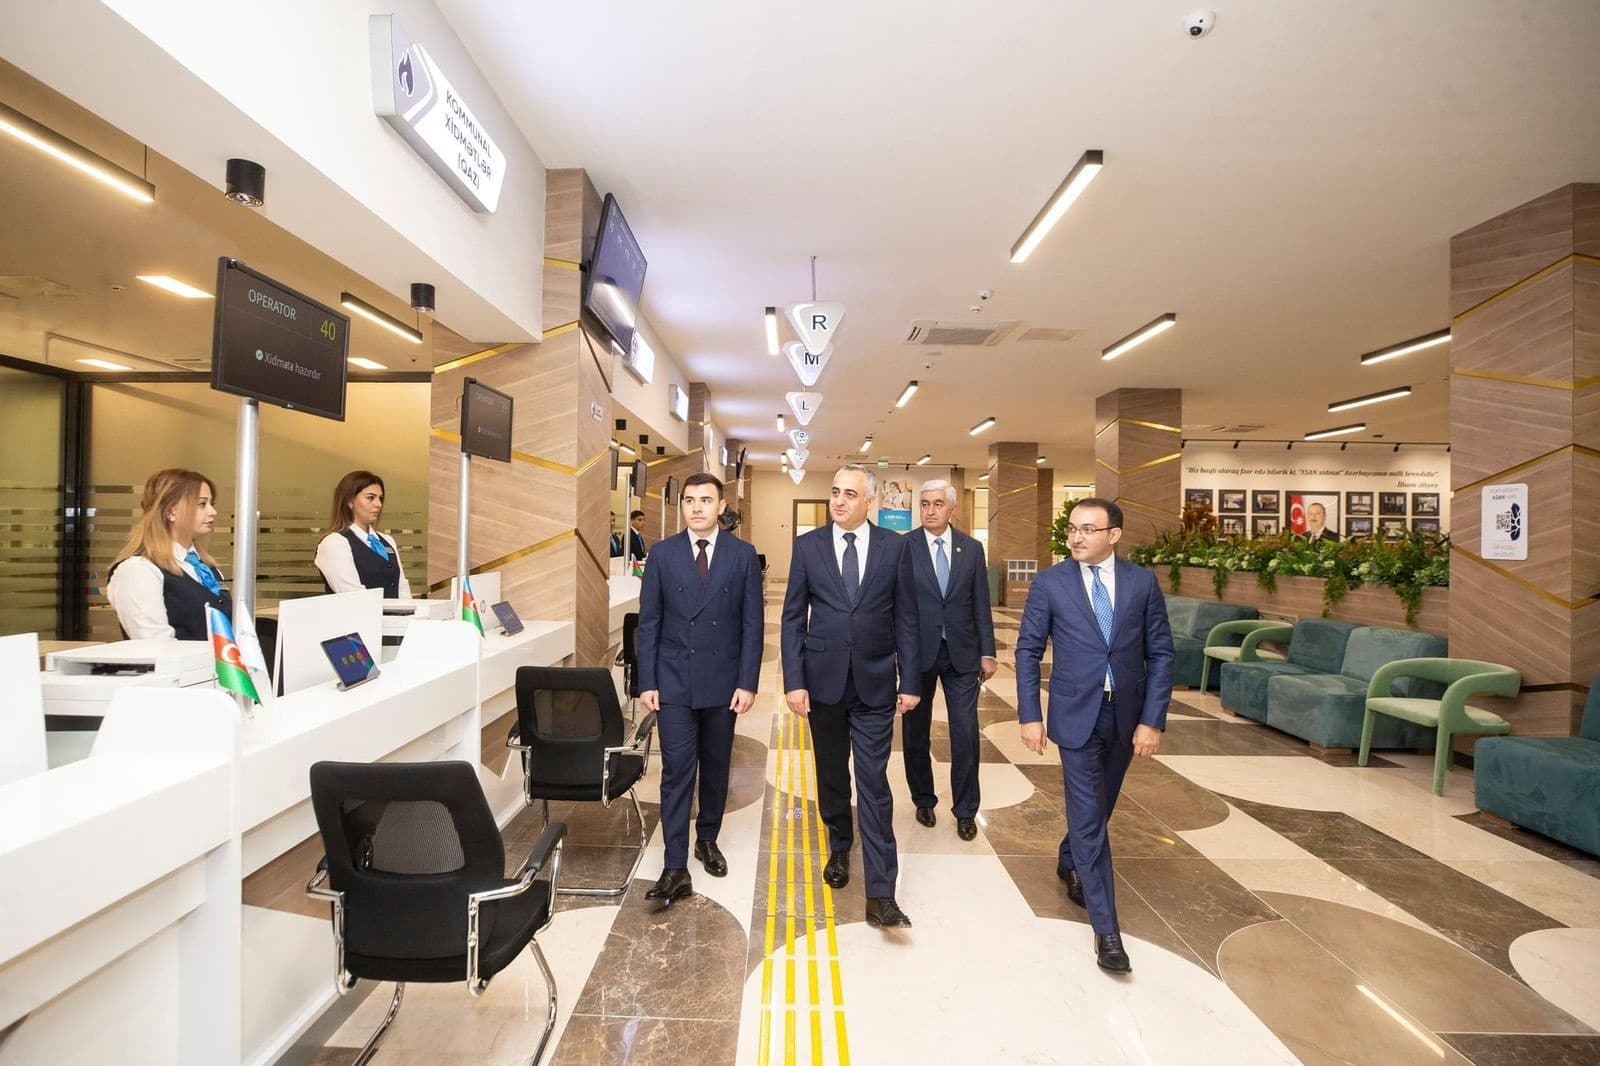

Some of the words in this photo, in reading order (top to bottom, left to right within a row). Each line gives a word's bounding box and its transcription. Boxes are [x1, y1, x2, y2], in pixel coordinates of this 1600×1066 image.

[446, 89, 491, 158] KOMMUNAL
[445, 112, 492, 180] XİDMƏTLƏR
[458, 152, 480, 190] (QAZ)
[248, 288, 297, 321] OPERATOR
[320, 319, 336, 341] 40
[812, 314, 827, 330] R
[804, 352, 819, 365] M
[802, 400, 810, 411] L
